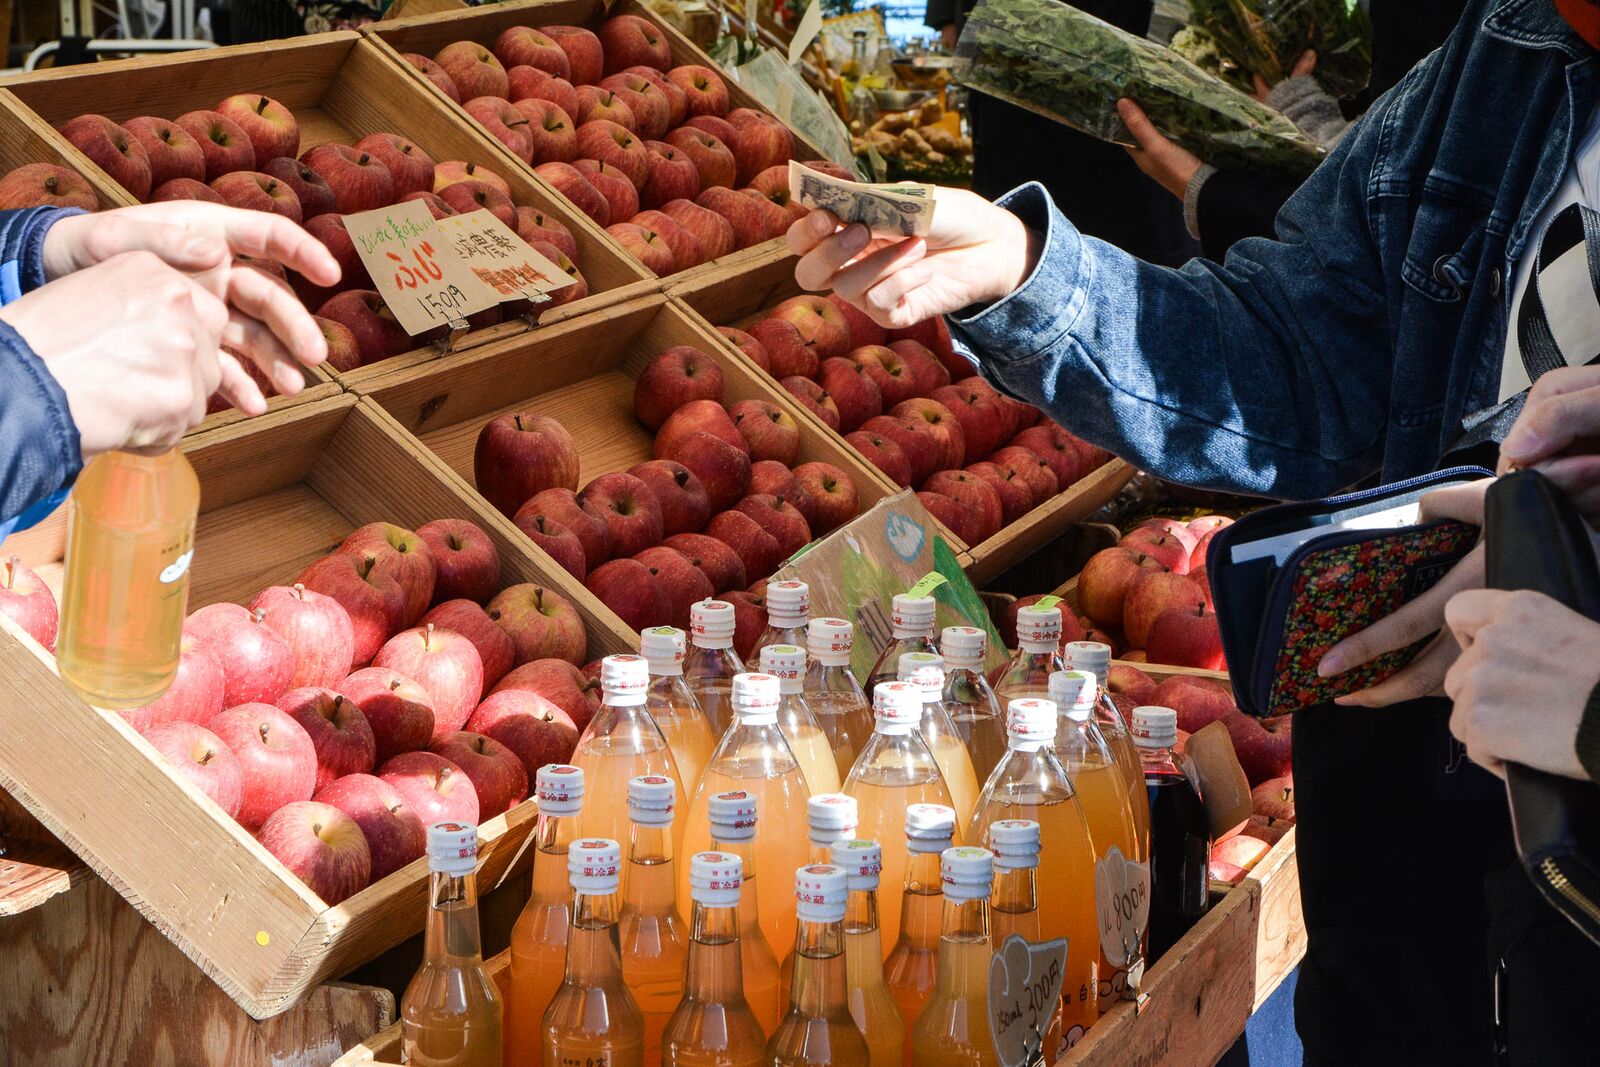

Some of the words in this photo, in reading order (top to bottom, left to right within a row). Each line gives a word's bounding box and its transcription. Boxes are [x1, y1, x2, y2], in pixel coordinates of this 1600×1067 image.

[385, 239, 443, 291] ふじ
[416, 284, 467, 320] 150円
[458, 846, 477, 860] 要冷
[583, 865, 617, 878] 要冷蔵
[858, 863, 882, 877] 要冷
[709, 878, 741, 890] 要冷蔵
[1112, 880, 1147, 932] 800円
[1024, 957, 1060, 1029] 300円
